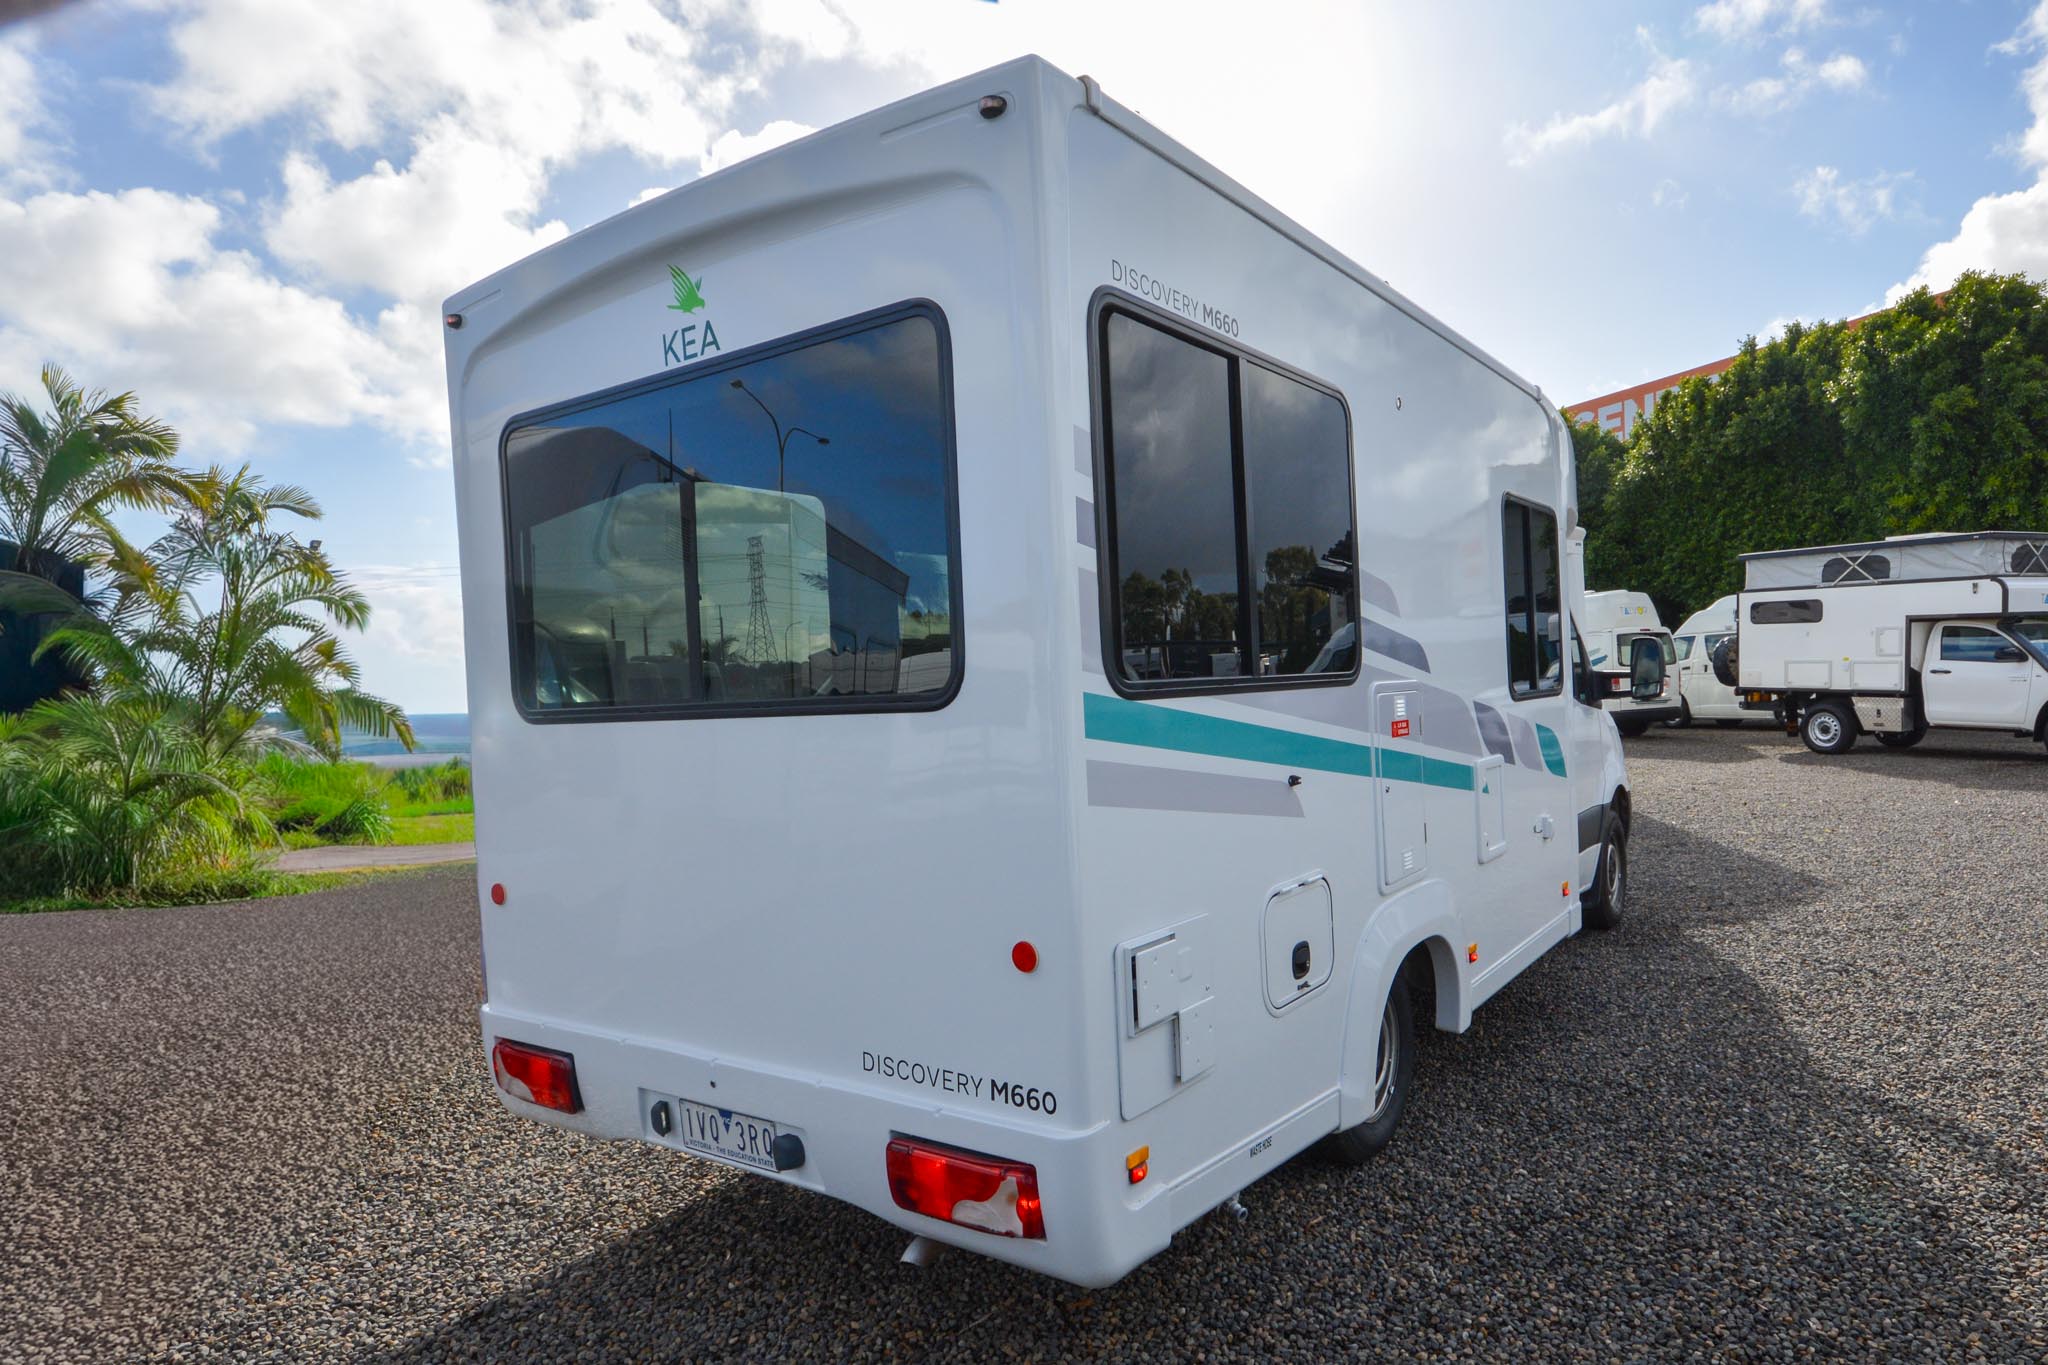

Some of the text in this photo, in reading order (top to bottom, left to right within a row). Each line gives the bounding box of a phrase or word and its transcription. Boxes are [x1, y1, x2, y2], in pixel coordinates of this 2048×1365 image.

[1111, 258, 1239, 338] DISCOVERY M660
[662, 319, 721, 367] KEA
[862, 1051, 1057, 1115] DISCOVERY M660
[686, 1108, 720, 1145] 1VQ
[735, 1120, 774, 1159] 3RQ
